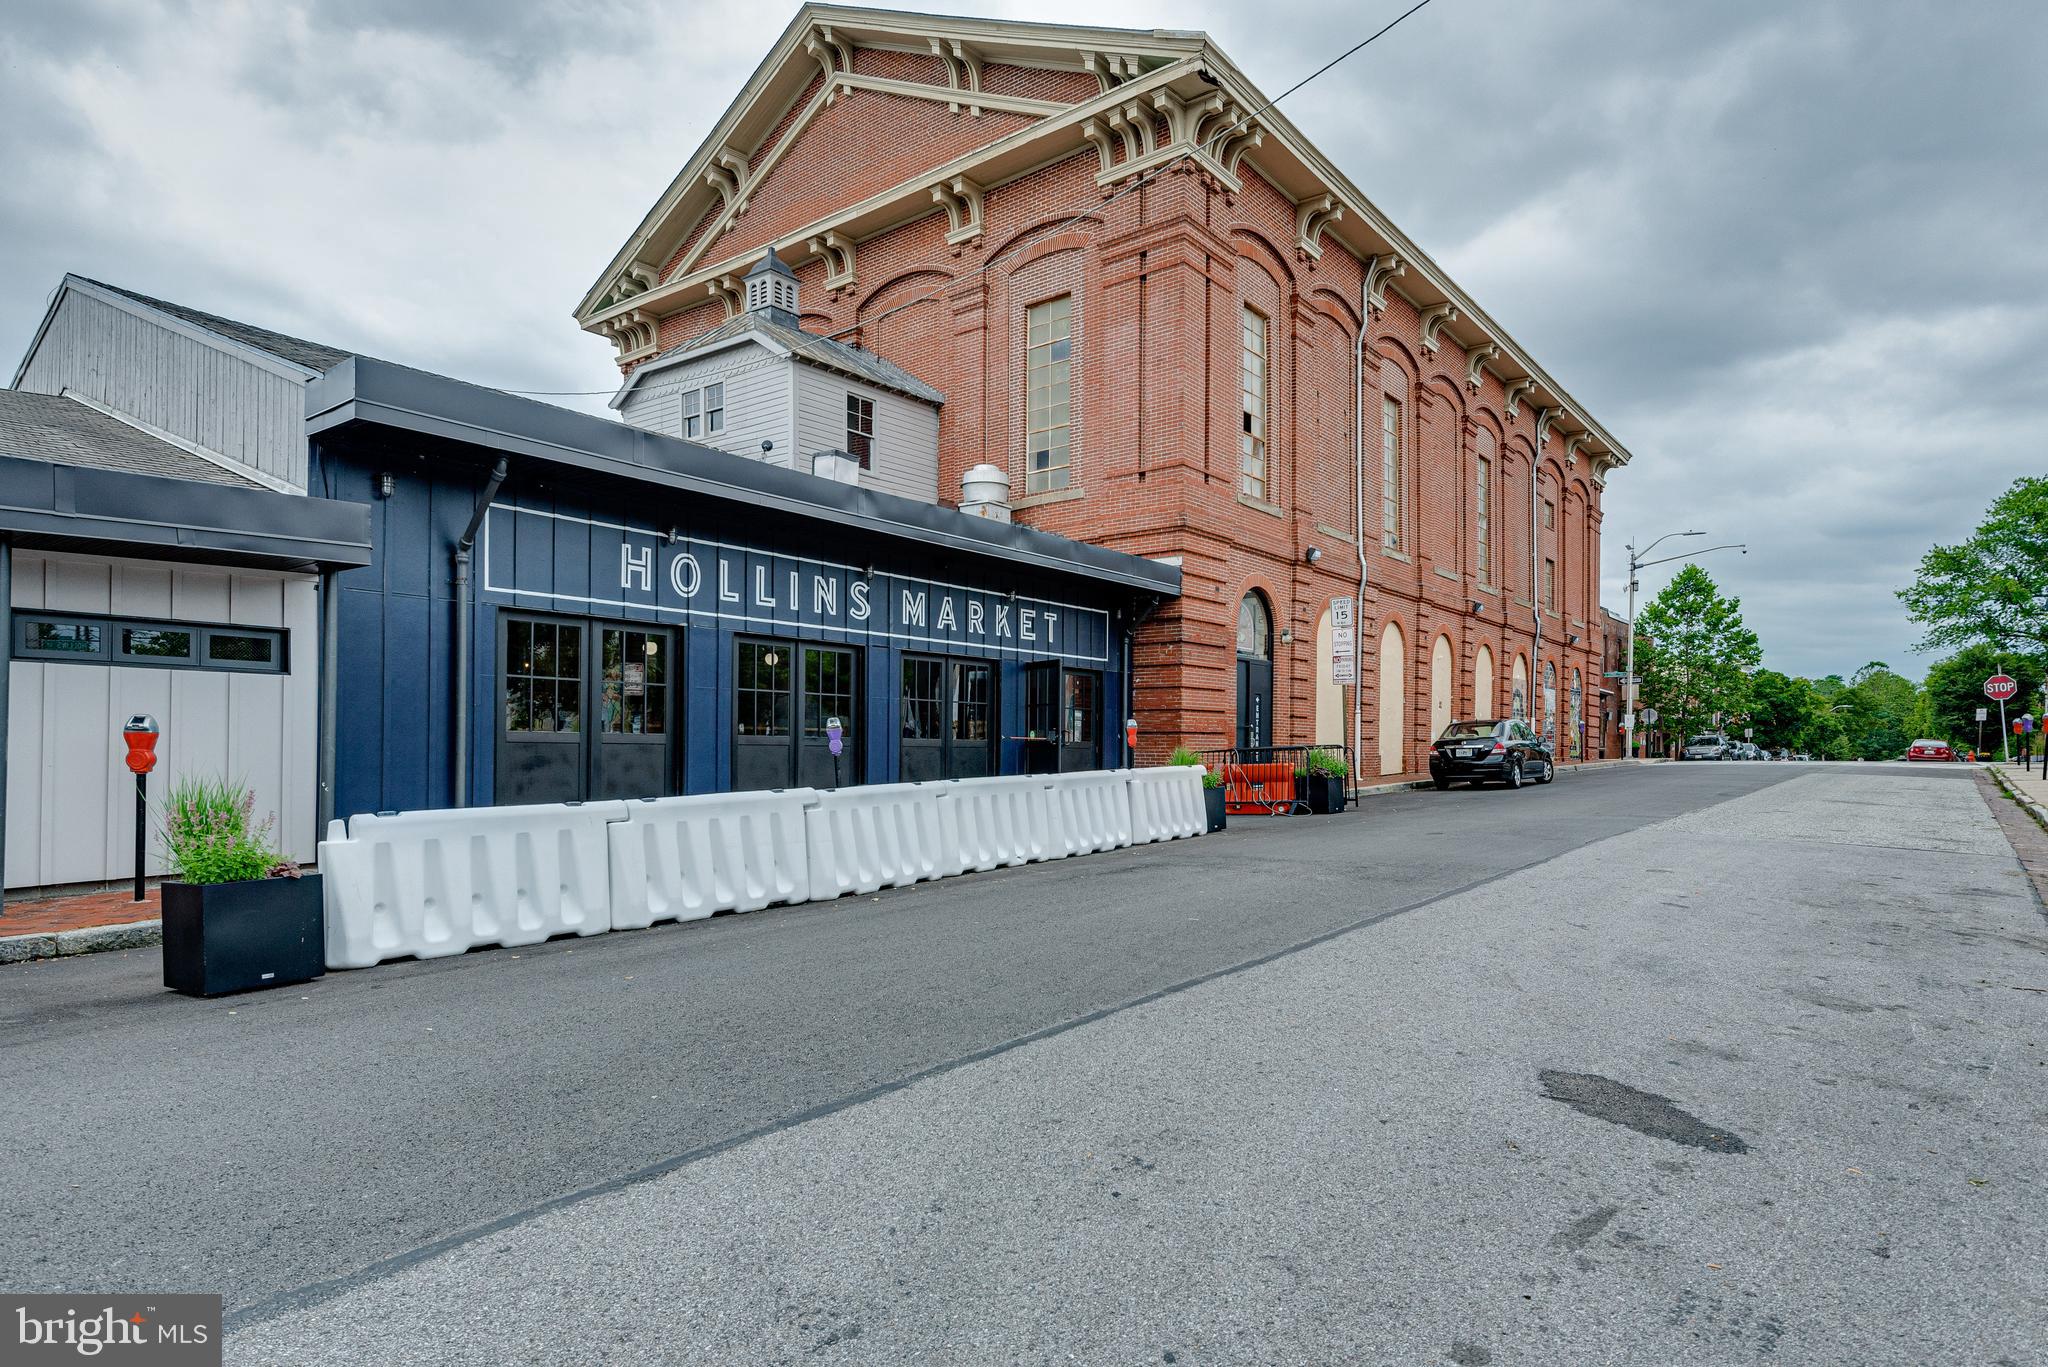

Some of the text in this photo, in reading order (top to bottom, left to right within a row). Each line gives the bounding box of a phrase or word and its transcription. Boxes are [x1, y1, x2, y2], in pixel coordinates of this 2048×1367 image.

[621, 543, 1057, 643] HOLLINS MARKET
[1335, 610, 1348, 620] 15
[1987, 682, 2014, 693] STOP
